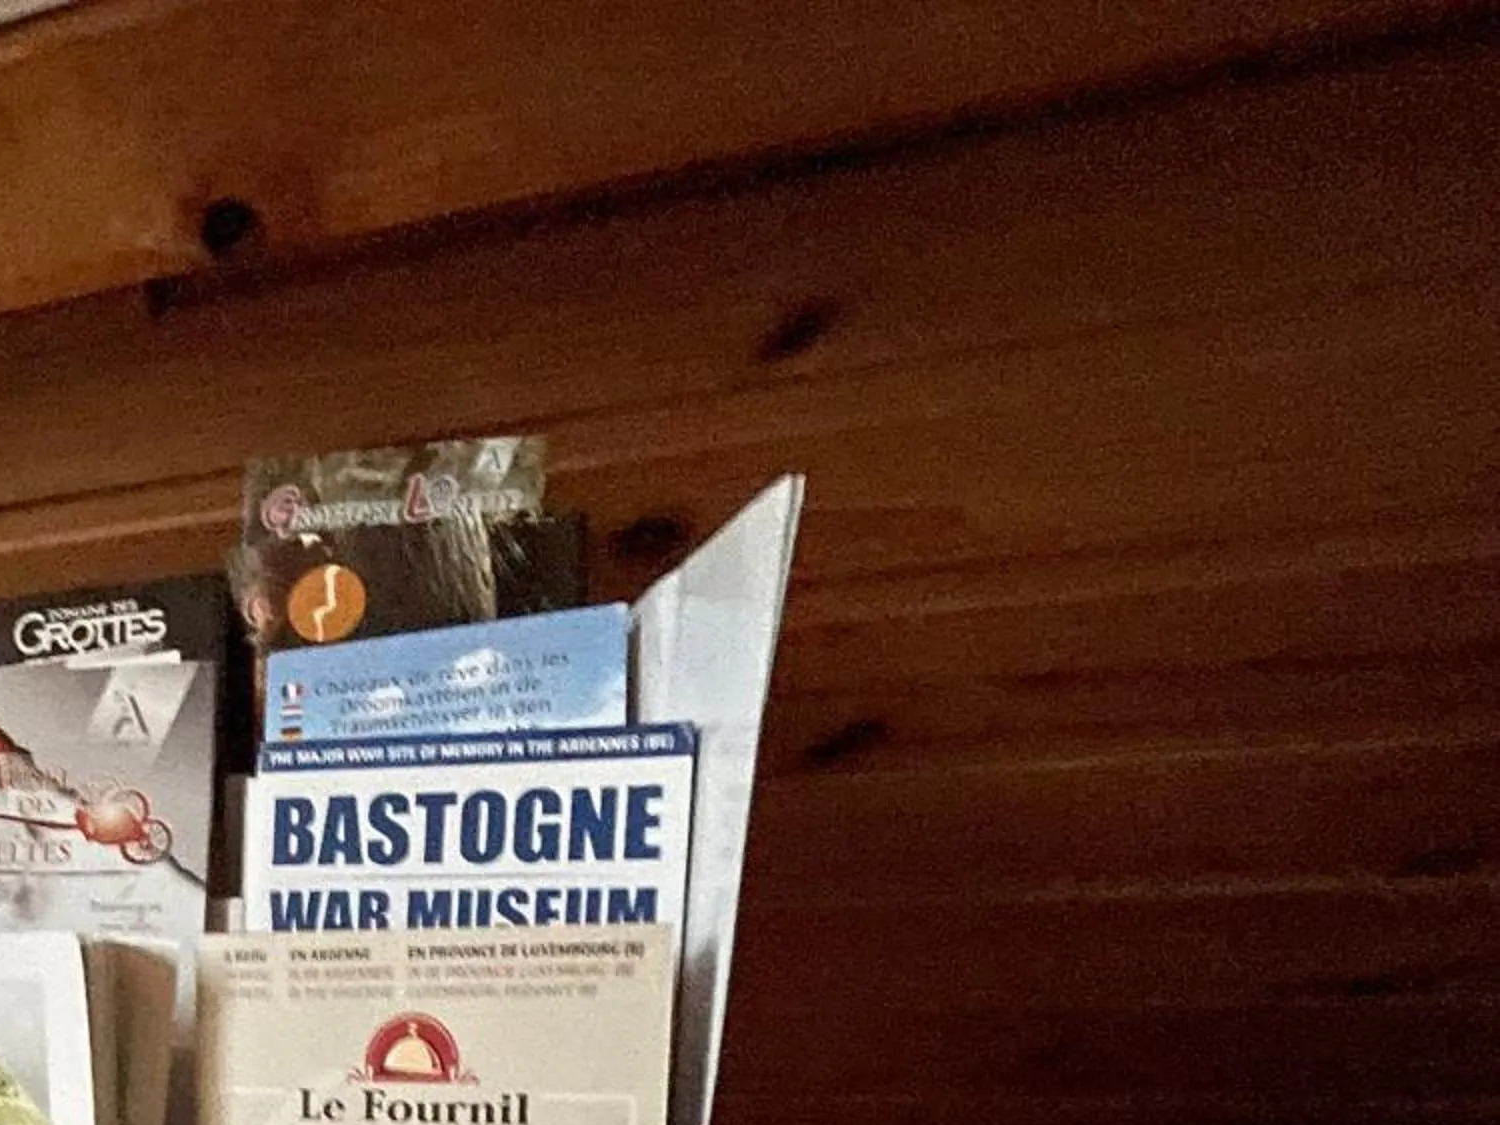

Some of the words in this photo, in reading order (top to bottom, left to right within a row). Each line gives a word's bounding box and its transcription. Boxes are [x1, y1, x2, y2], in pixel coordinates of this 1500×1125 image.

[14, 609, 167, 655] GROTTES
[296, 749, 344, 764] MAJOR
[557, 734, 640, 755] ARDENNES
[271, 784, 664, 867] BASTOGNE
[269, 887, 391, 932] WAR
[406, 886, 658, 930] MUSEUM
[300, 1087, 346, 1121] Le
